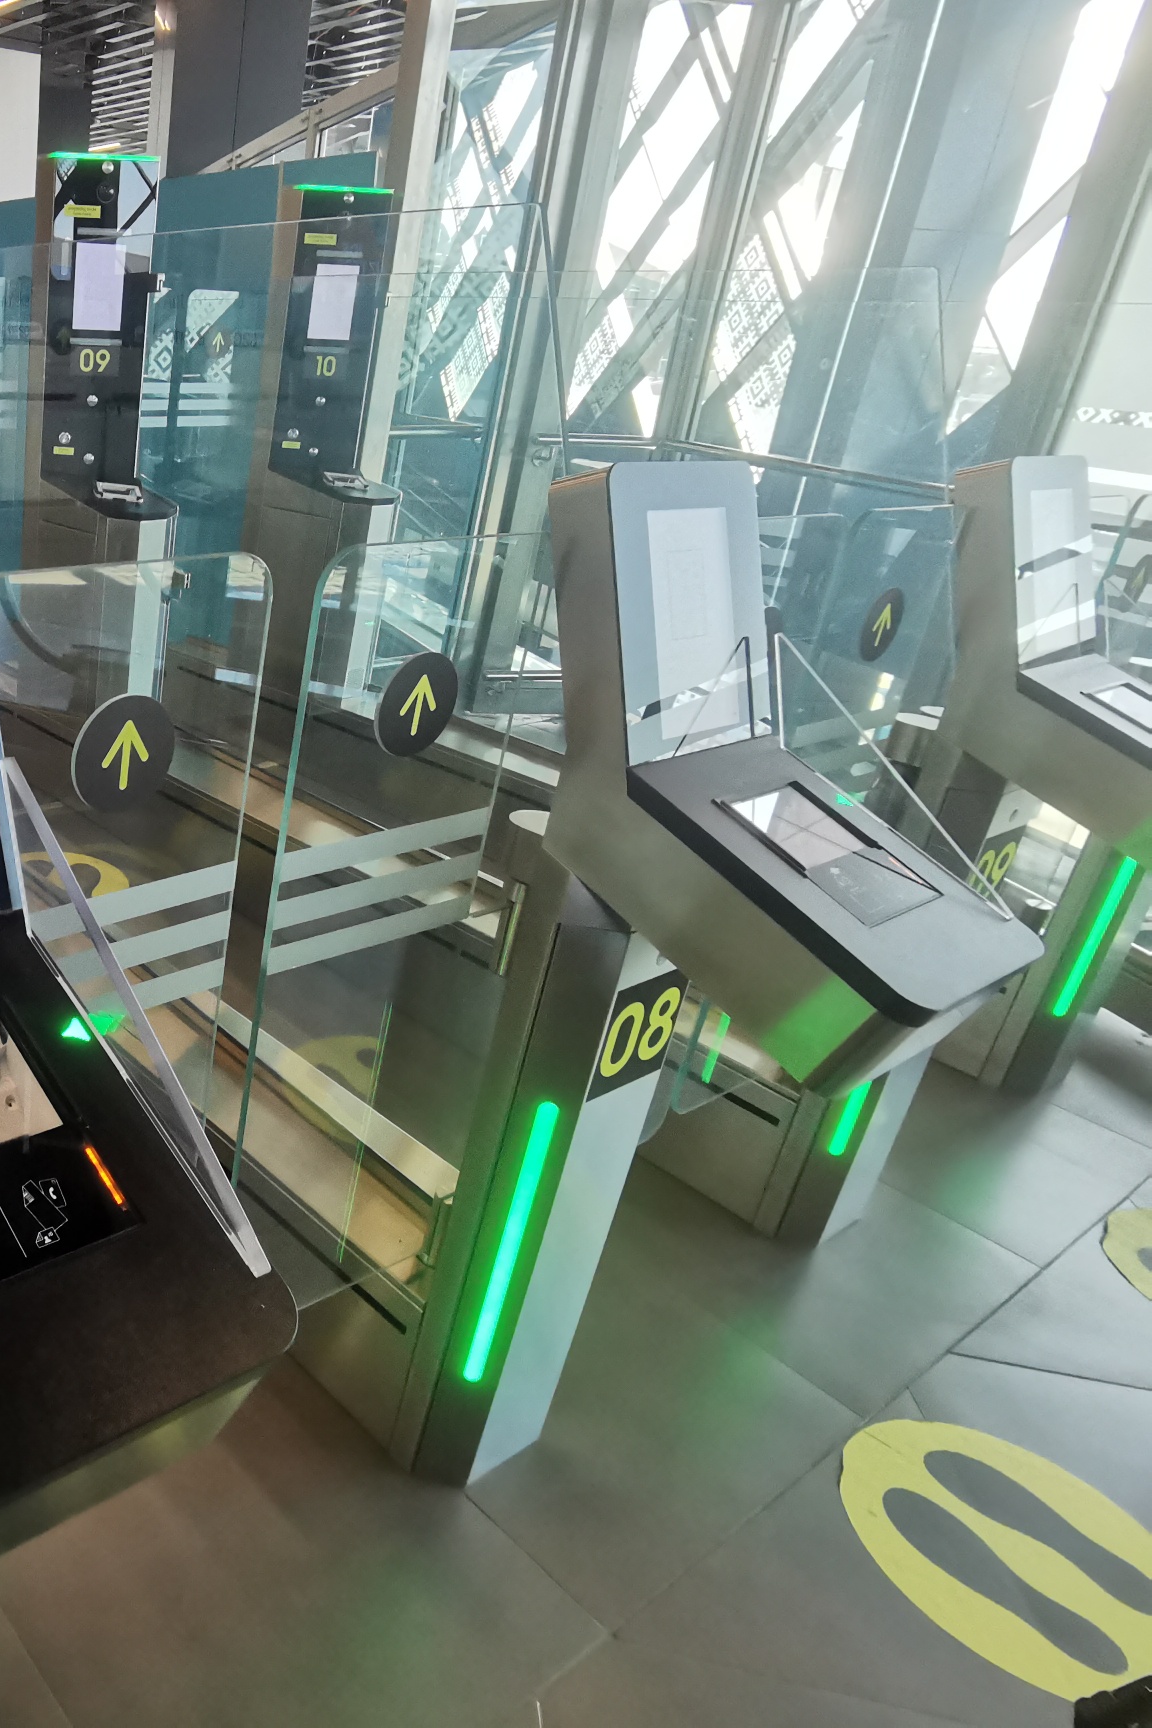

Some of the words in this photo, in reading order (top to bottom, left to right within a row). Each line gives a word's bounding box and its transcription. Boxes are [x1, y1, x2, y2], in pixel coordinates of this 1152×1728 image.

[79, 348, 111, 373] 09
[316, 355, 337, 377] 10
[600, 986, 681, 1077] 08
